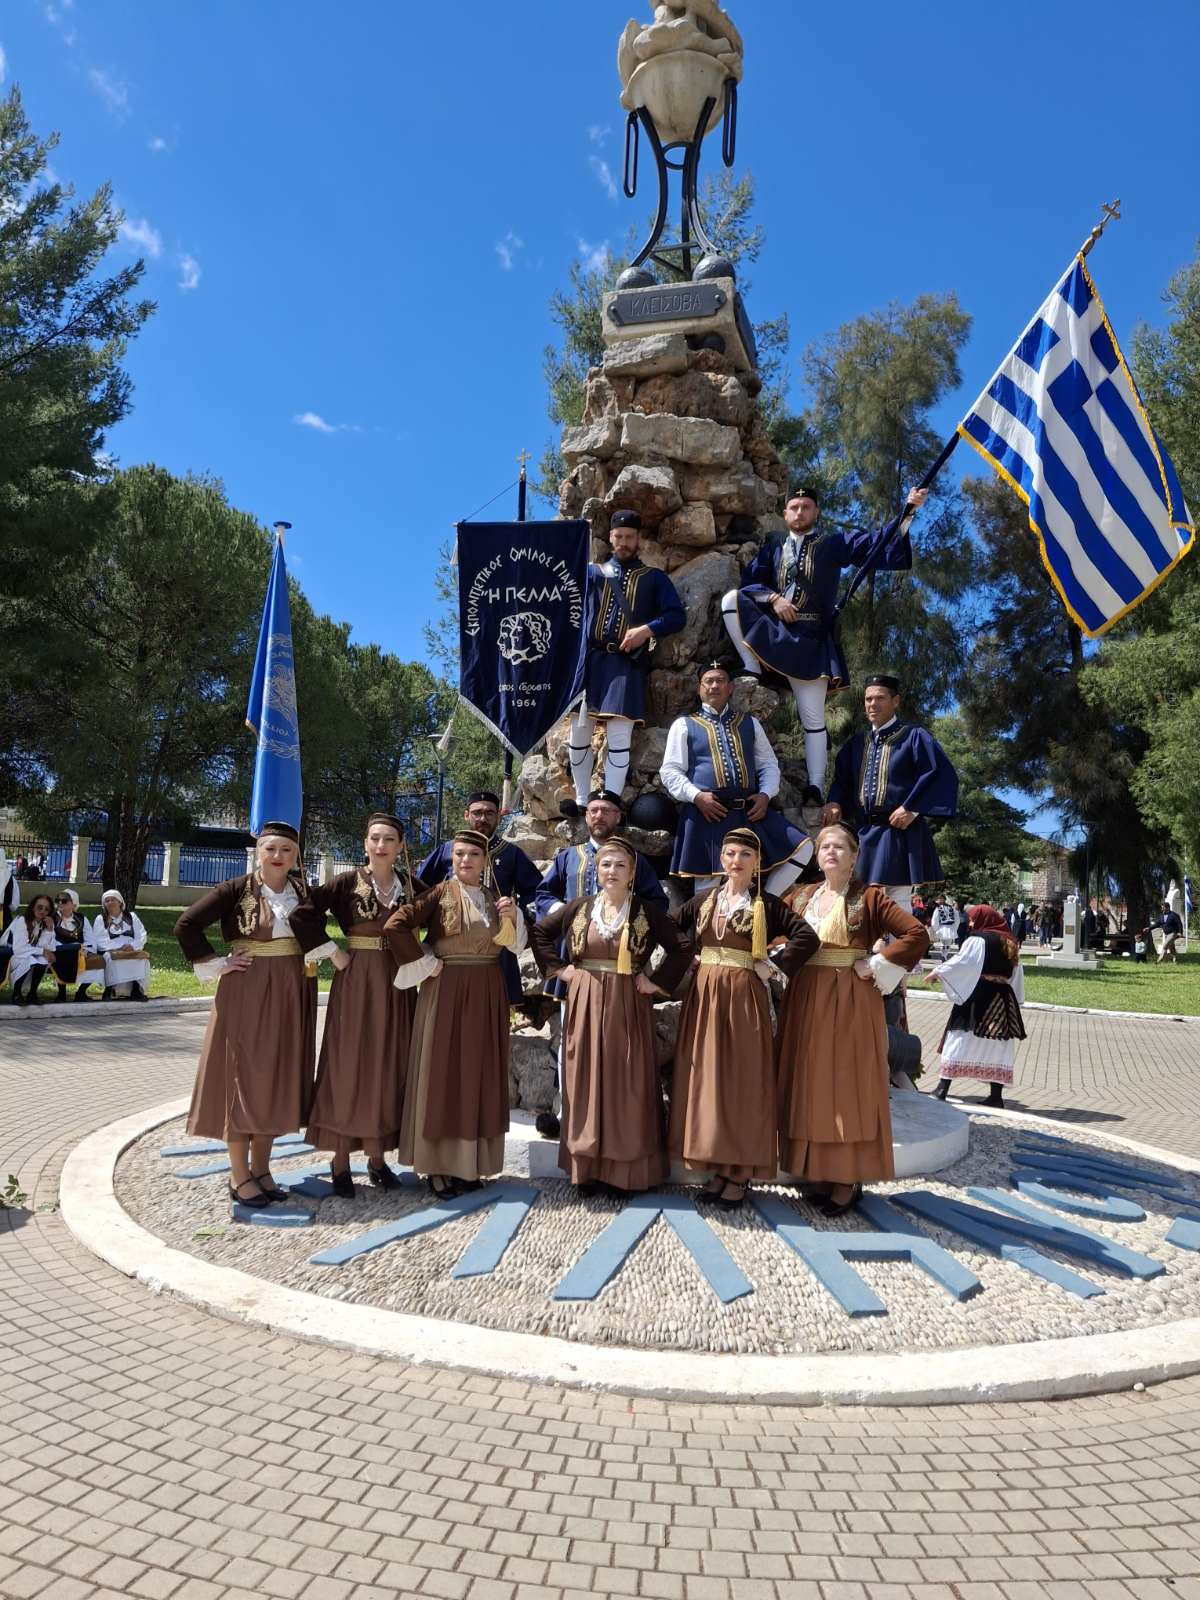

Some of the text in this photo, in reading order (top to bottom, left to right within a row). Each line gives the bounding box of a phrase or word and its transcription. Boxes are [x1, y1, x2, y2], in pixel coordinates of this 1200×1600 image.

[630, 293, 702, 317] ΚΛΕΙΣΟΒΑ
[509, 547, 553, 568] ΟΜΙΛΟΣ
[511, 698, 537, 708] 1964
